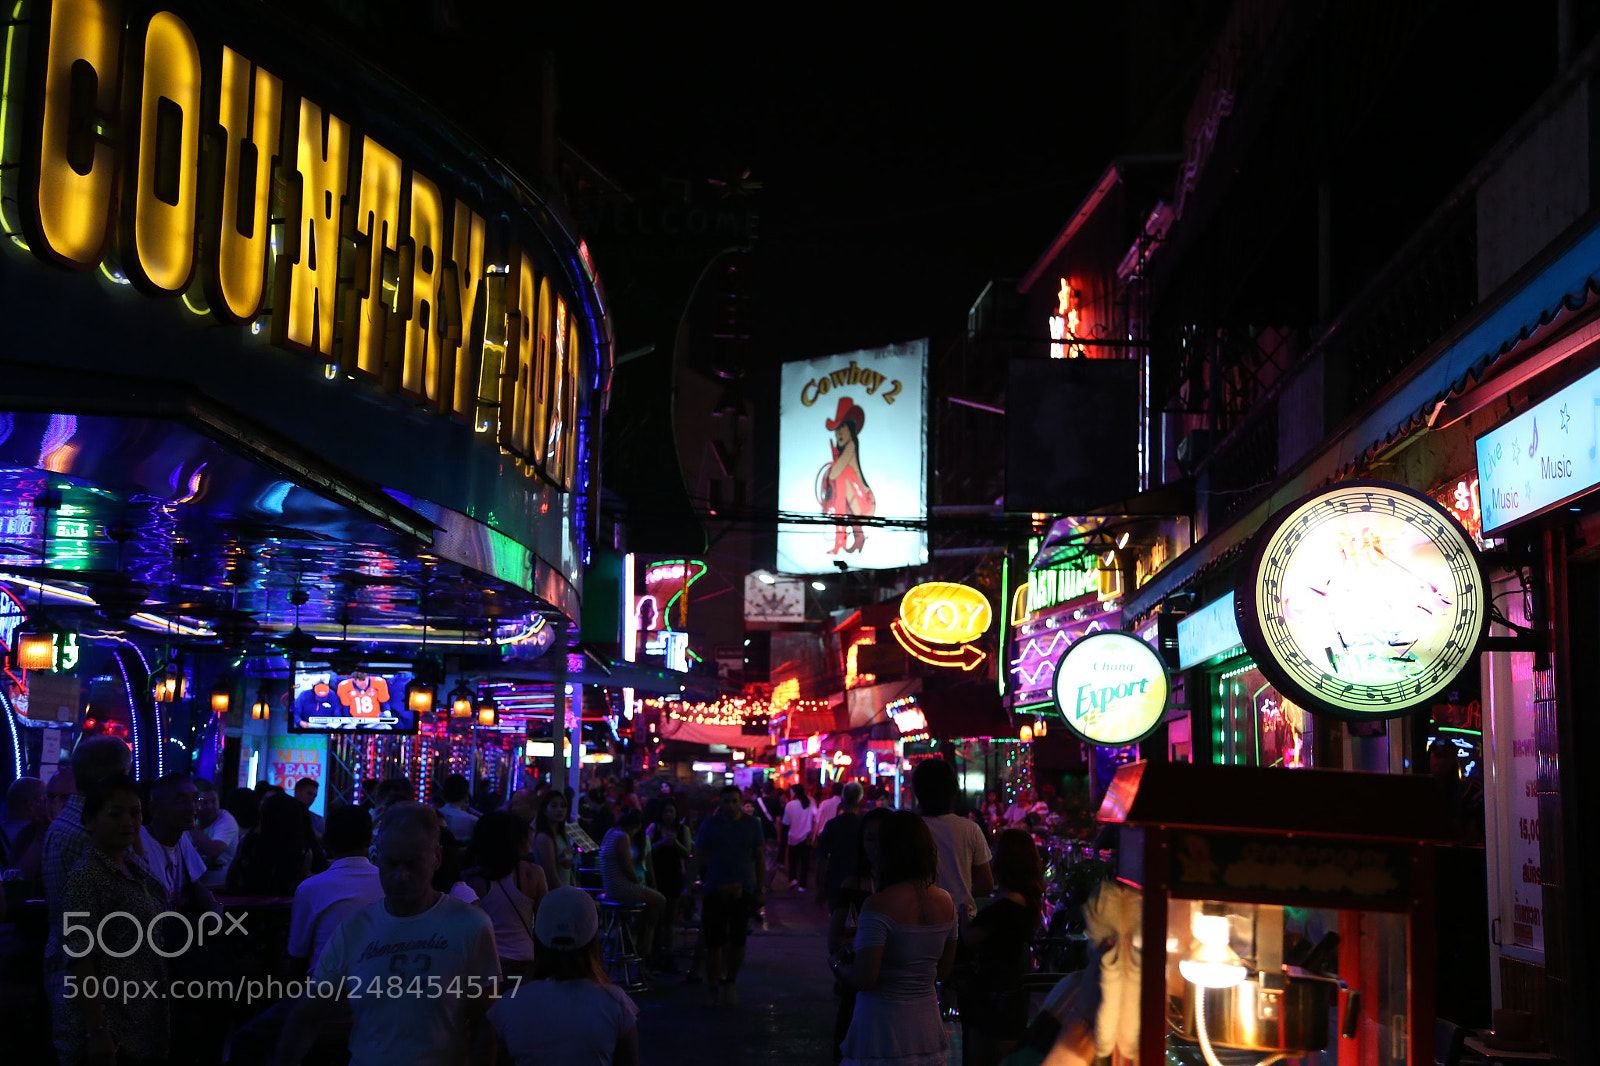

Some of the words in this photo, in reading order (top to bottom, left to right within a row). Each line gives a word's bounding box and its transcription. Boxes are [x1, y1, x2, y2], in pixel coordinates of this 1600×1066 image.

[37, 0, 487, 424] COUNTRY
[801, 361, 888, 407] Cowboy
[882, 379, 903, 405] 2
[1483, 442, 1502, 481] Live
[1541, 454, 1572, 480] Music
[1491, 486, 1519, 509] Music
[913, 599, 984, 633] TOY
[354, 696, 374, 714] 18
[1076, 678, 1149, 720] Export
[273, 737, 325, 749] HAPPY
[275, 763, 319, 776] YEAR
[278, 750, 317, 763] NEW
